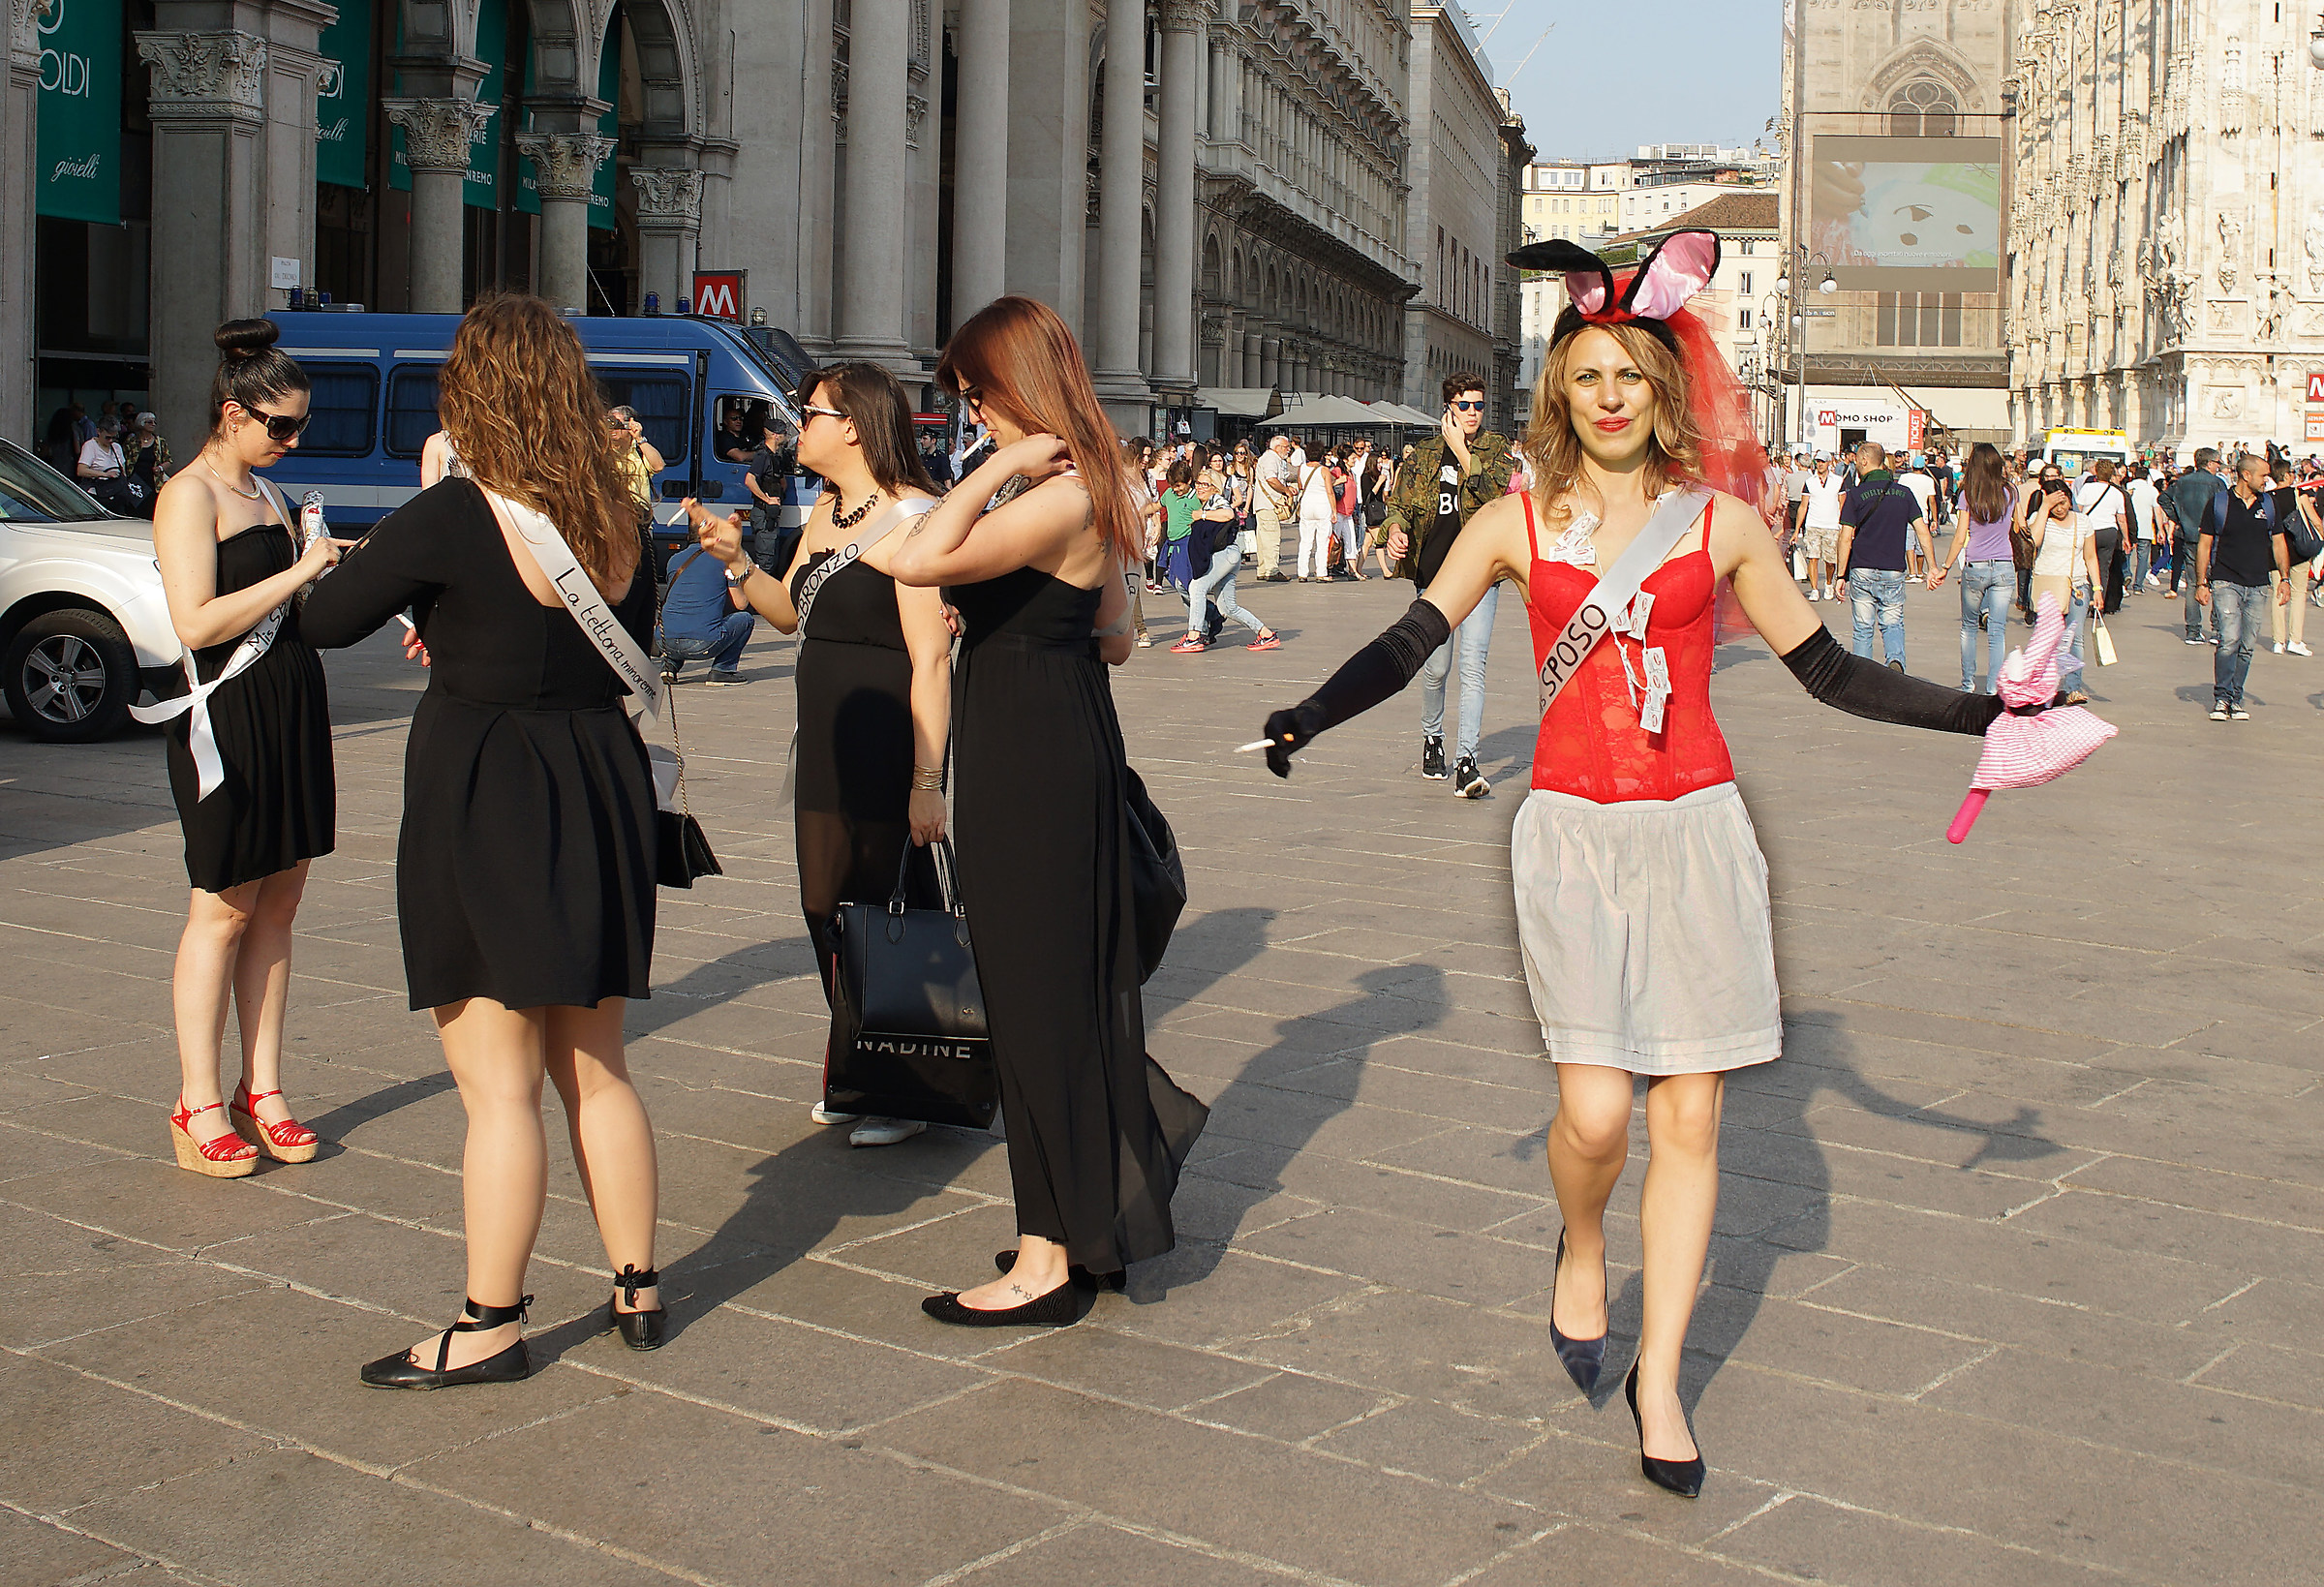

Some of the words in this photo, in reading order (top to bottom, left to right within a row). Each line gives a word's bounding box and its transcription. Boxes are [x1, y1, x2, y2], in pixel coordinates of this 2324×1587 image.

[50, 153, 101, 183] gioielli
[697, 284, 737, 316] M
[1820, 412, 1835, 424] M
[1863, 414, 1893, 423] SHOP
[1911, 413, 1920, 445] TICKET
[555, 566, 581, 607] La
[580, 603, 625, 663] tettona
[1541, 603, 1607, 697] SPOSO
